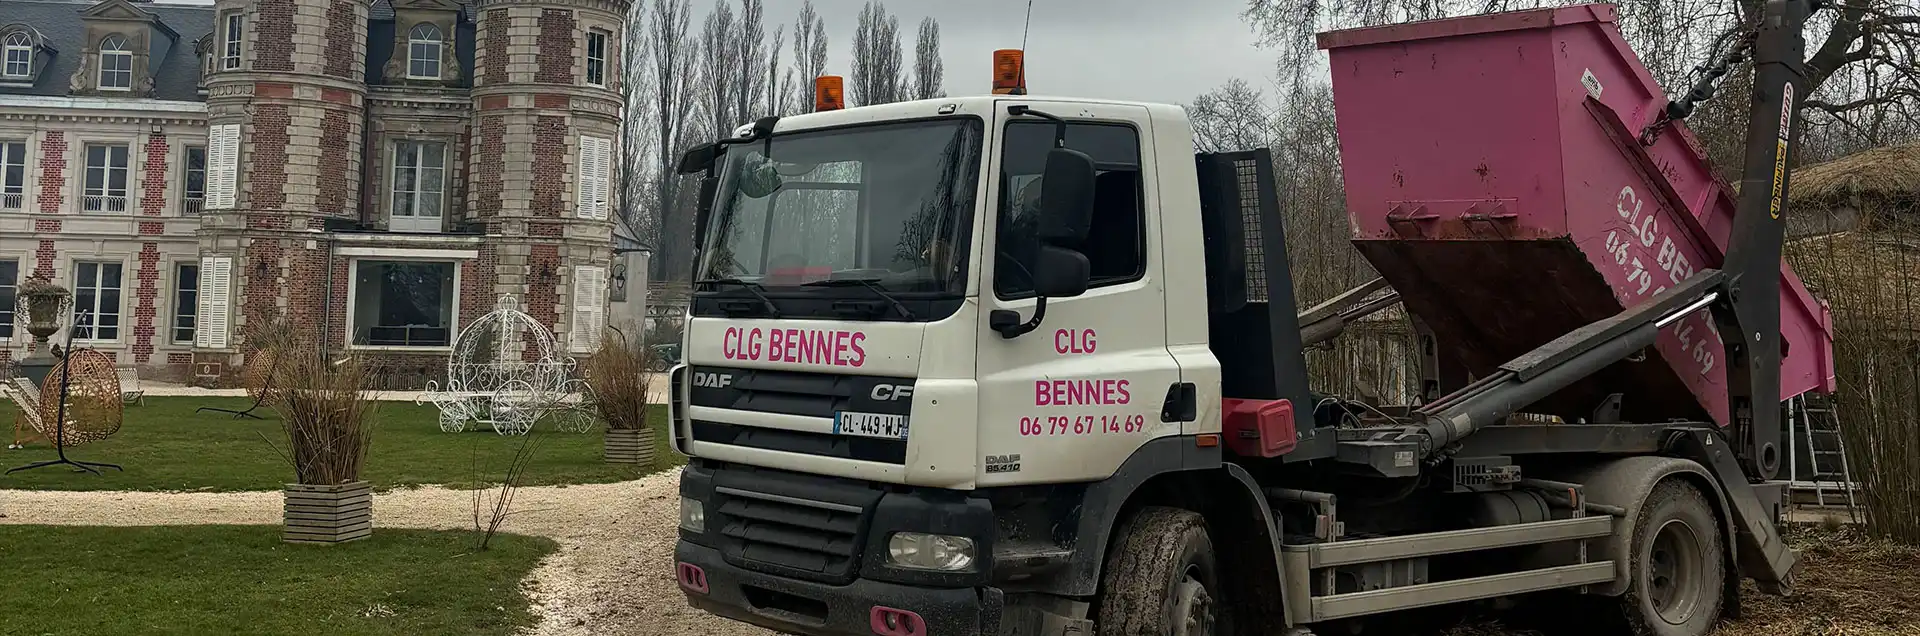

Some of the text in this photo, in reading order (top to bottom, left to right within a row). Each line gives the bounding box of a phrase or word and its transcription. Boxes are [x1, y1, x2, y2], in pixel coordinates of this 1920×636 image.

[1616, 185, 1658, 248] CLG
[1605, 231, 1630, 266] 06
[1627, 256, 1652, 295] 79
[1692, 339, 1714, 375] 69
[723, 326, 866, 367] CLG BENNES
[1054, 328, 1097, 355] CLG
[693, 372, 732, 388] DAF
[870, 383, 914, 401] CF
[1035, 379, 1131, 406] BENNES
[1020, 414, 1144, 436] 06 79 67 14 69
[986, 453, 1020, 464] DAF
